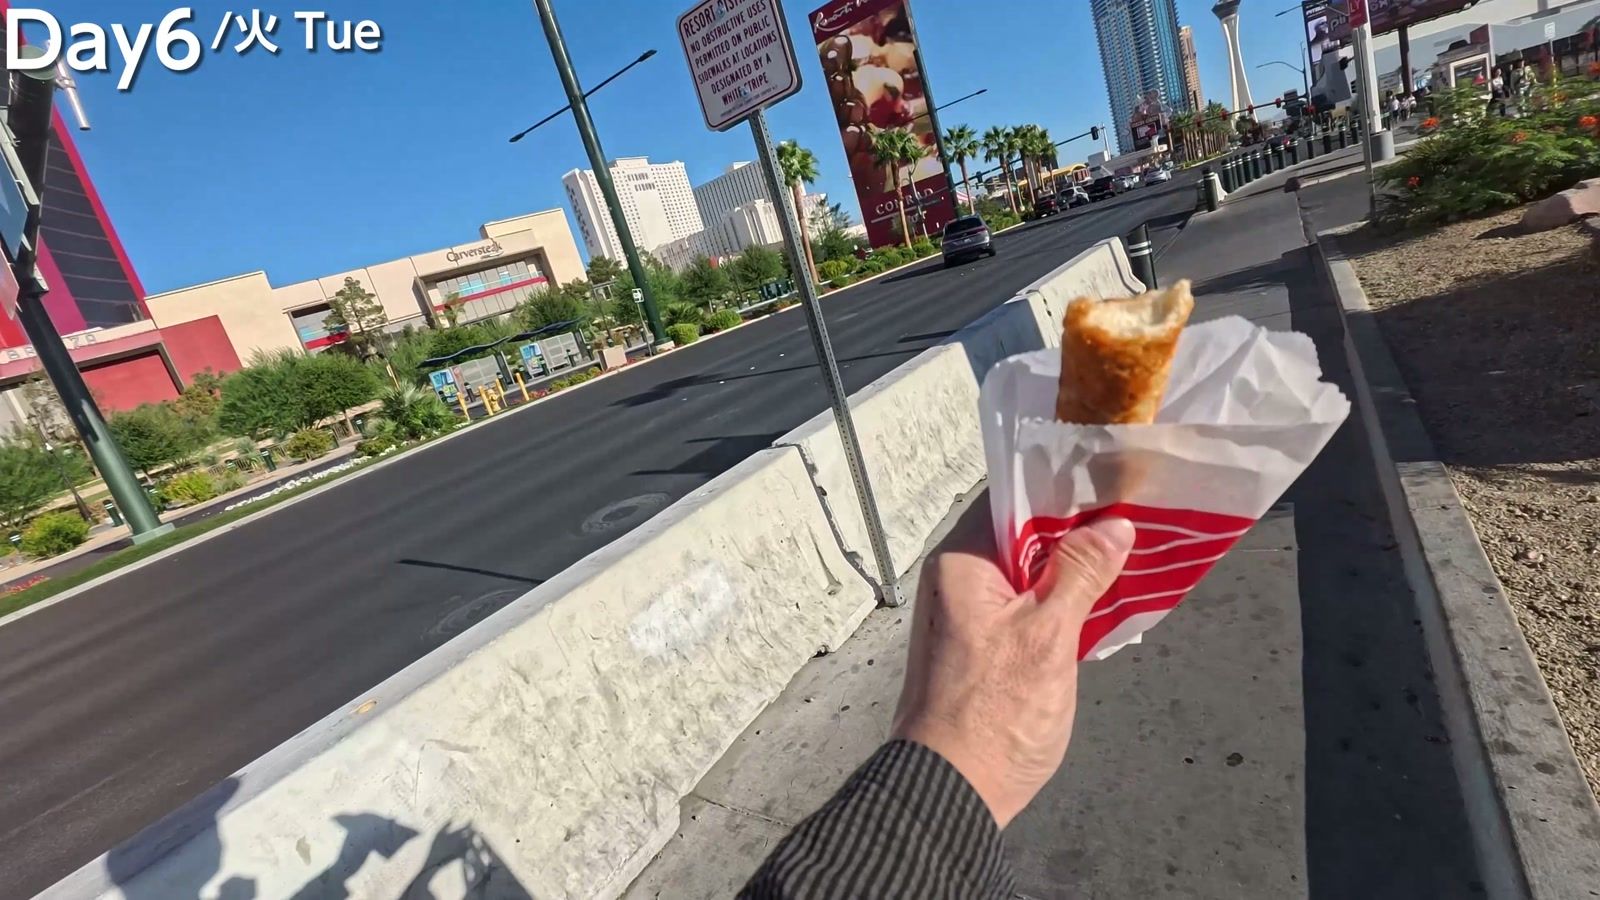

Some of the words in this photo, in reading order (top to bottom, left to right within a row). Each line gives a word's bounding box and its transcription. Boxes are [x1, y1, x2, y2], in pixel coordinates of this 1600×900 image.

[683, 5, 716, 38] RESORT
[690, 41, 701, 54] NO
[702, 13, 746, 47] OBSTRUCTIVE
[747, 1, 767, 19] USES
[695, 41, 730, 69] PERMITTED
[731, 34, 743, 47] ON
[743, 15, 771, 39] PUBLIC
[697, 58, 732, 85] SIDEWALKS
[732, 52, 740, 66] AT
[740, 30, 778, 60] LOCATIONS
[711, 64, 752, 94] DESIGNATED
[753, 57, 764, 71] BY
[765, 53, 772, 65] A
[721, 86, 742, 106] WHITE
[446, 237, 503, 264] Carversteak
